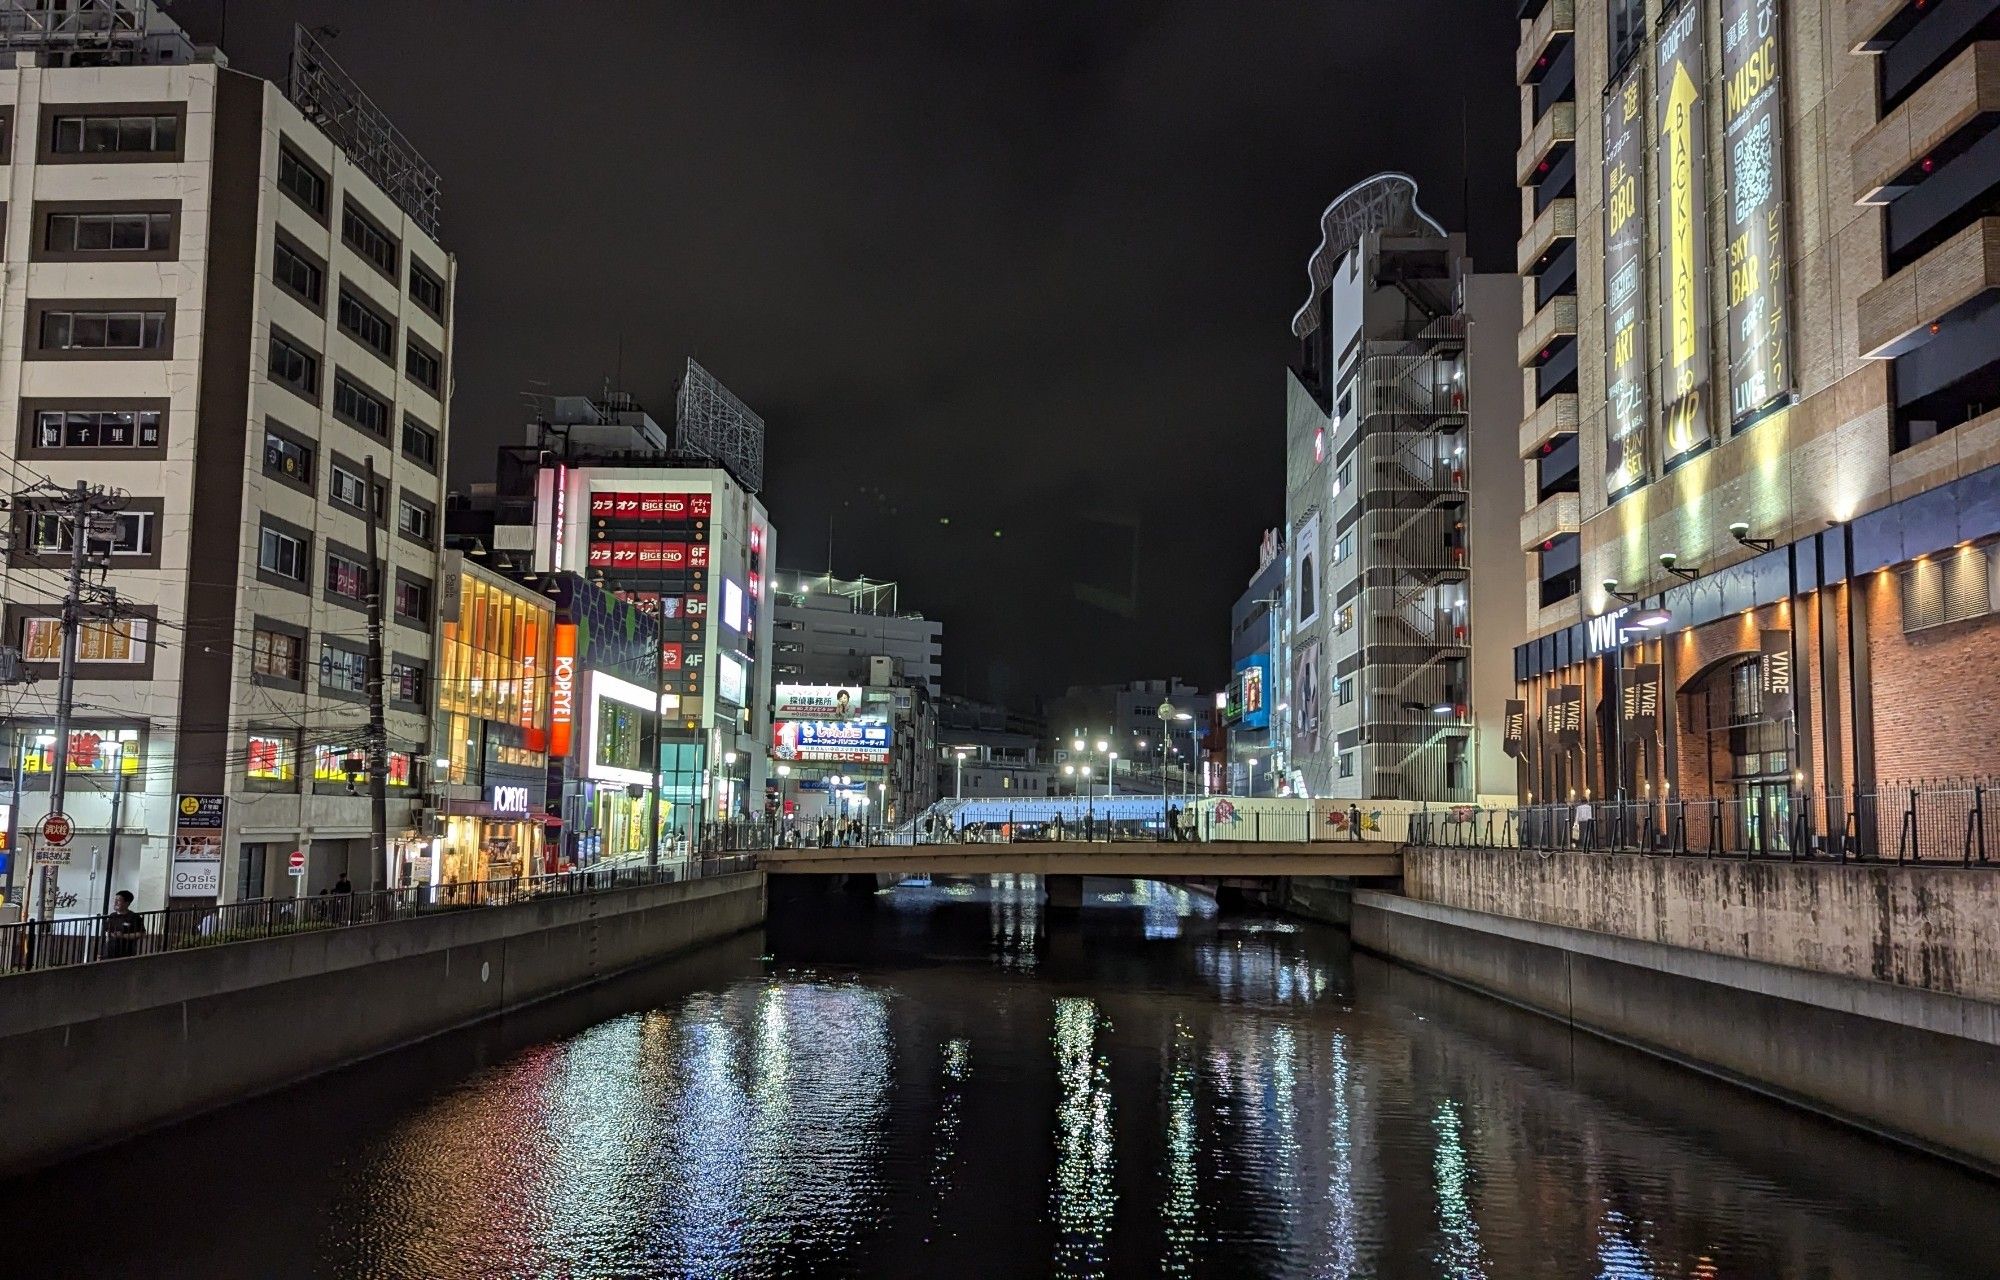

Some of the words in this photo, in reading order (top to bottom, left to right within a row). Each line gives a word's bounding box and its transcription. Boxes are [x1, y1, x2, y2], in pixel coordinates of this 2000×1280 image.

[1661, 6, 1696, 66] ROOFTOP
[1727, 35, 1775, 122] MUSIC
[1610, 175, 1635, 238] BBQ
[1675, 102, 1689, 346] BACKYARD
[1731, 230, 1749, 267] SKY
[1731, 254, 1760, 308] BAR
[1614, 322, 1635, 371] ART
[1677, 369, 1694, 396] GO
[1669, 390, 1700, 450] UP
[1626, 453, 1643, 477] SET
[691, 547, 707, 557] 6F
[686, 598, 707, 615] 5F
[685, 654, 703, 666] 4F
[1762, 654, 1770, 691] YOKOHAMA
[1771, 651, 1789, 694] VIVRE
[1566, 700, 1581, 731] VIVRE
[1641, 681, 1657, 717] VIVRE
[1510, 713, 1523, 741] VIVRE
[1058, 752, 1067, 763] P
[493, 785, 528, 812] POPEYE!
[45, 825, 67, 835] 消火栓
[176, 872, 217, 883] Oasis
